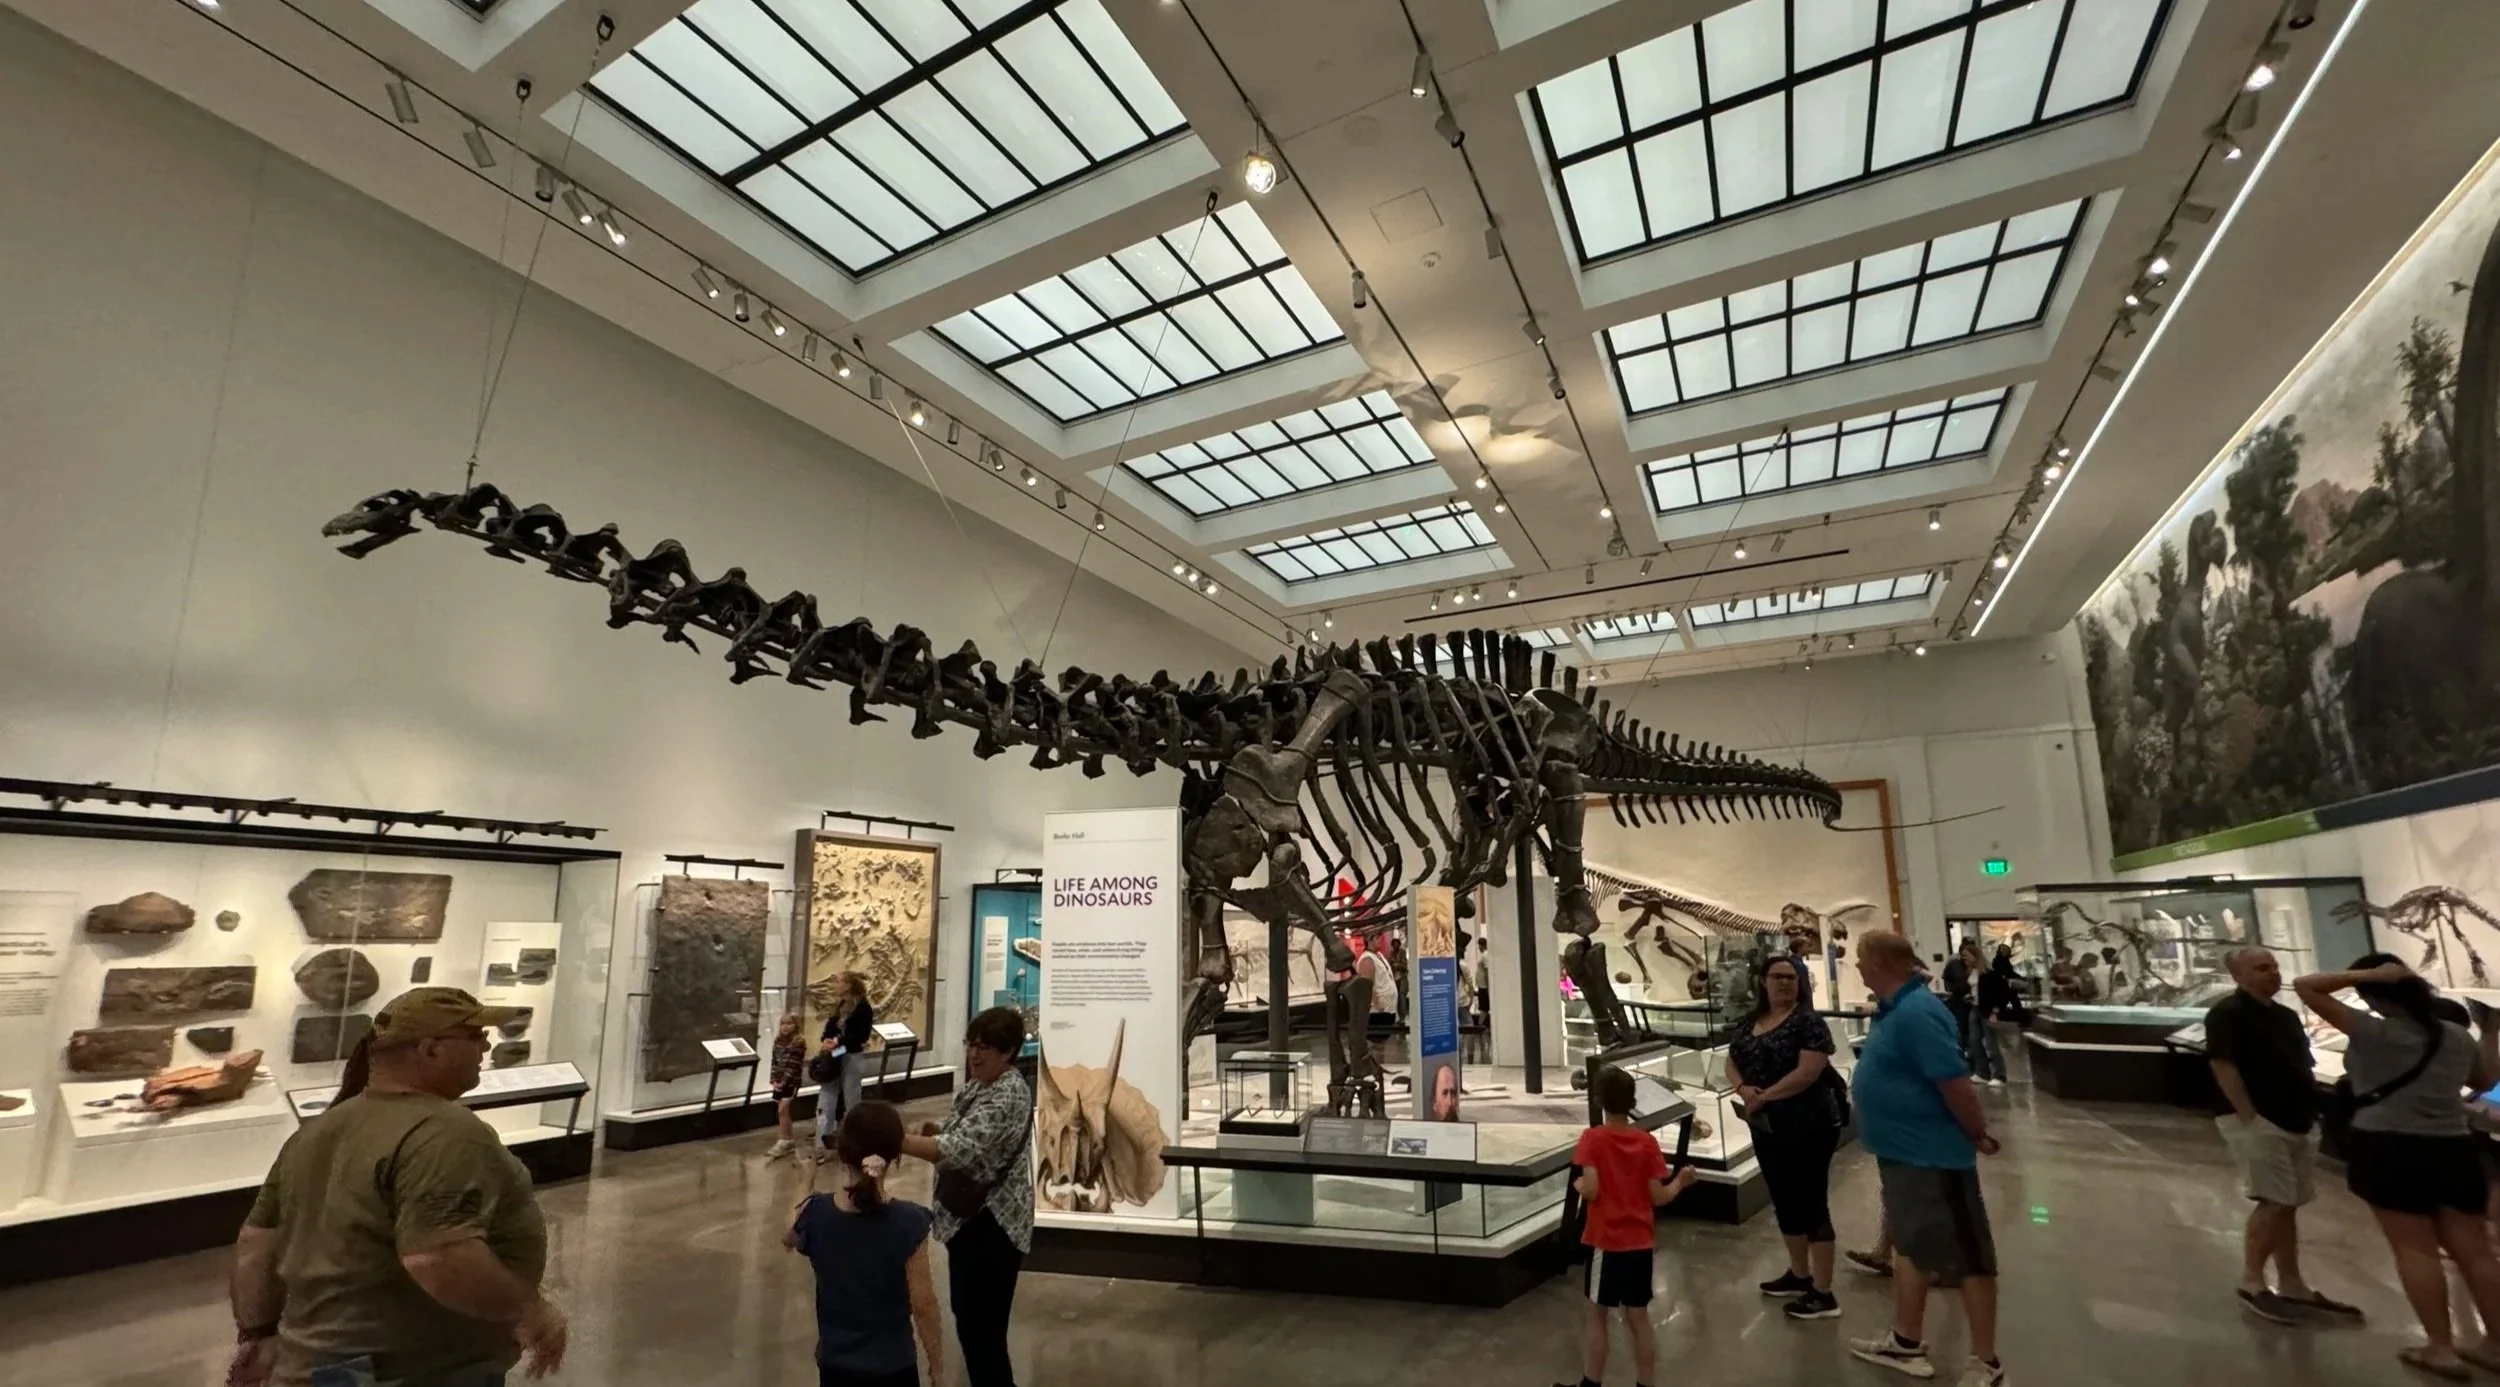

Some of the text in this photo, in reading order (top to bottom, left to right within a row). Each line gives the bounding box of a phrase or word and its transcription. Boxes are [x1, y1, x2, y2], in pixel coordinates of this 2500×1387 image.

[1054, 876, 1158, 892] LIFE AMONG
[1054, 892, 1152, 907] DINOSAURS
